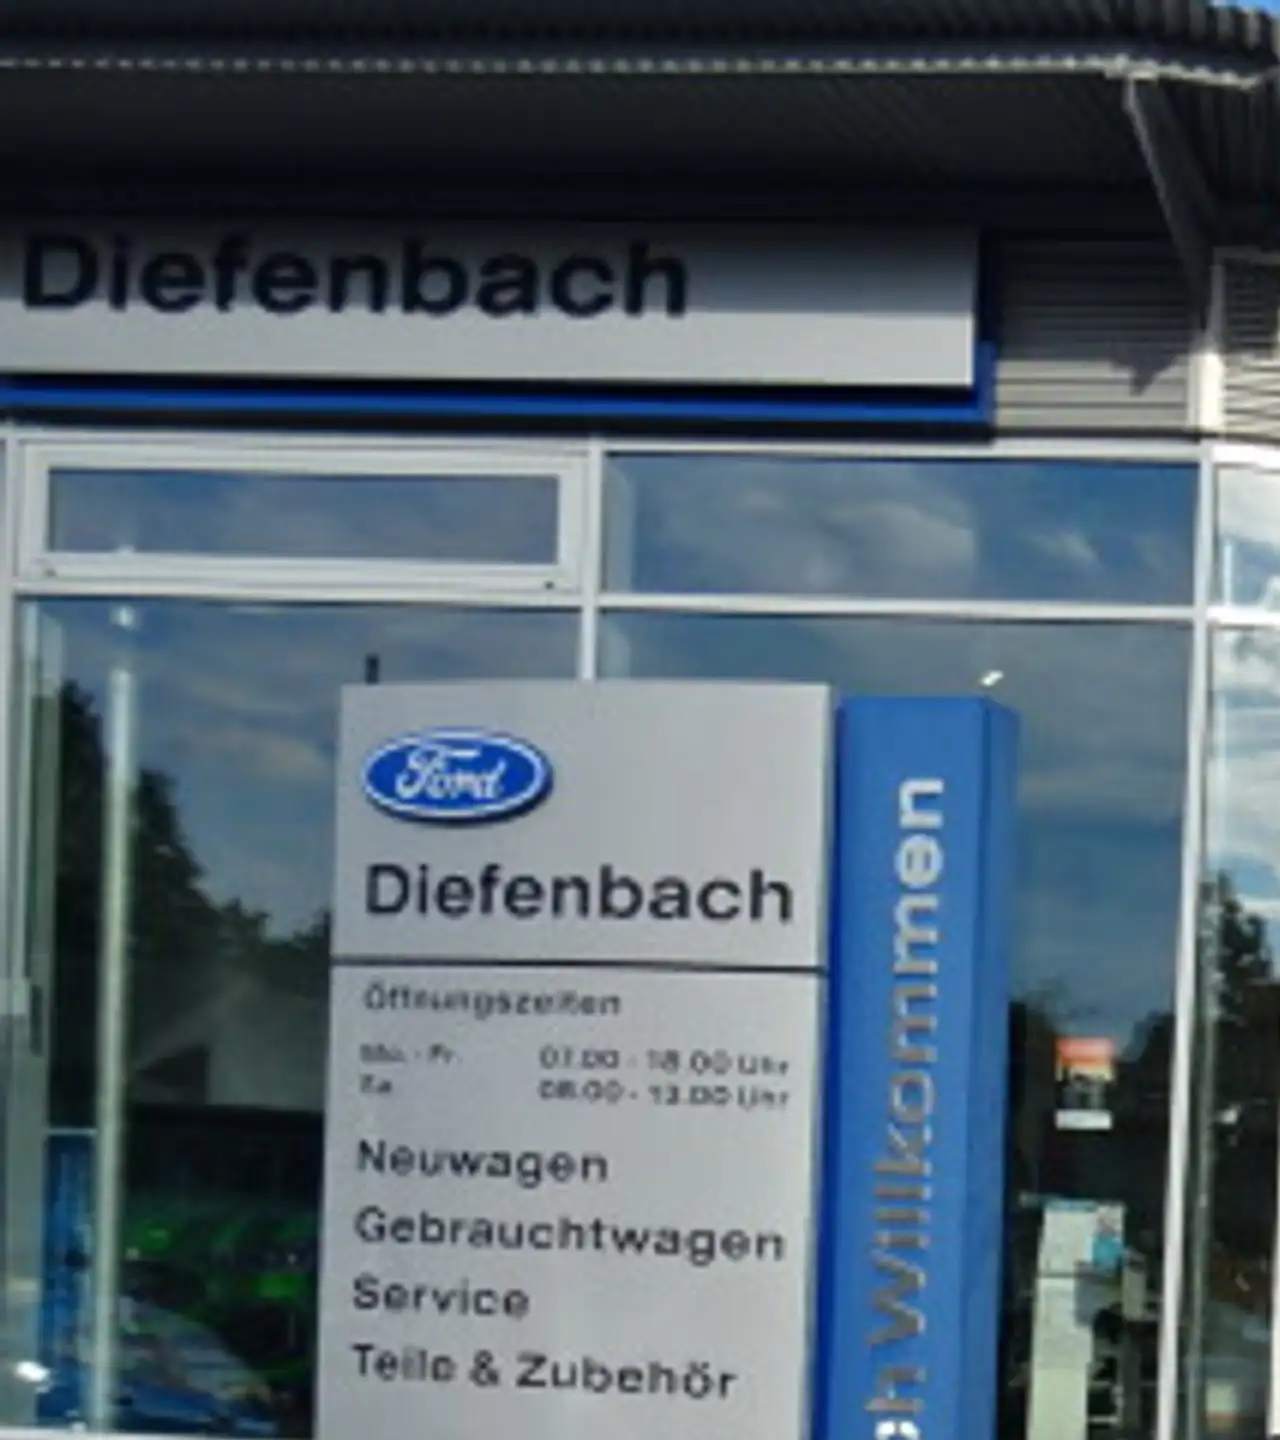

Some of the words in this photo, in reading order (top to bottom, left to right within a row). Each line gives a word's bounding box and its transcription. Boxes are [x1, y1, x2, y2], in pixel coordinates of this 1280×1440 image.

[22, 232, 690, 319] Diefenbach
[394, 745, 508, 800] Ford
[365, 862, 793, 923] Diefenbach
[363, 979, 622, 1022] Öffnungszeiten
[864, 776, 946, 1347] Willkommen
[355, 1138, 609, 1188] Neuwagen
[353, 1205, 787, 1268] Gebrauchtwagen
[352, 1273, 530, 1319] Service
[351, 1343, 457, 1384] Teile
[469, 1351, 501, 1388] &
[515, 1351, 739, 1401] Zubehör
